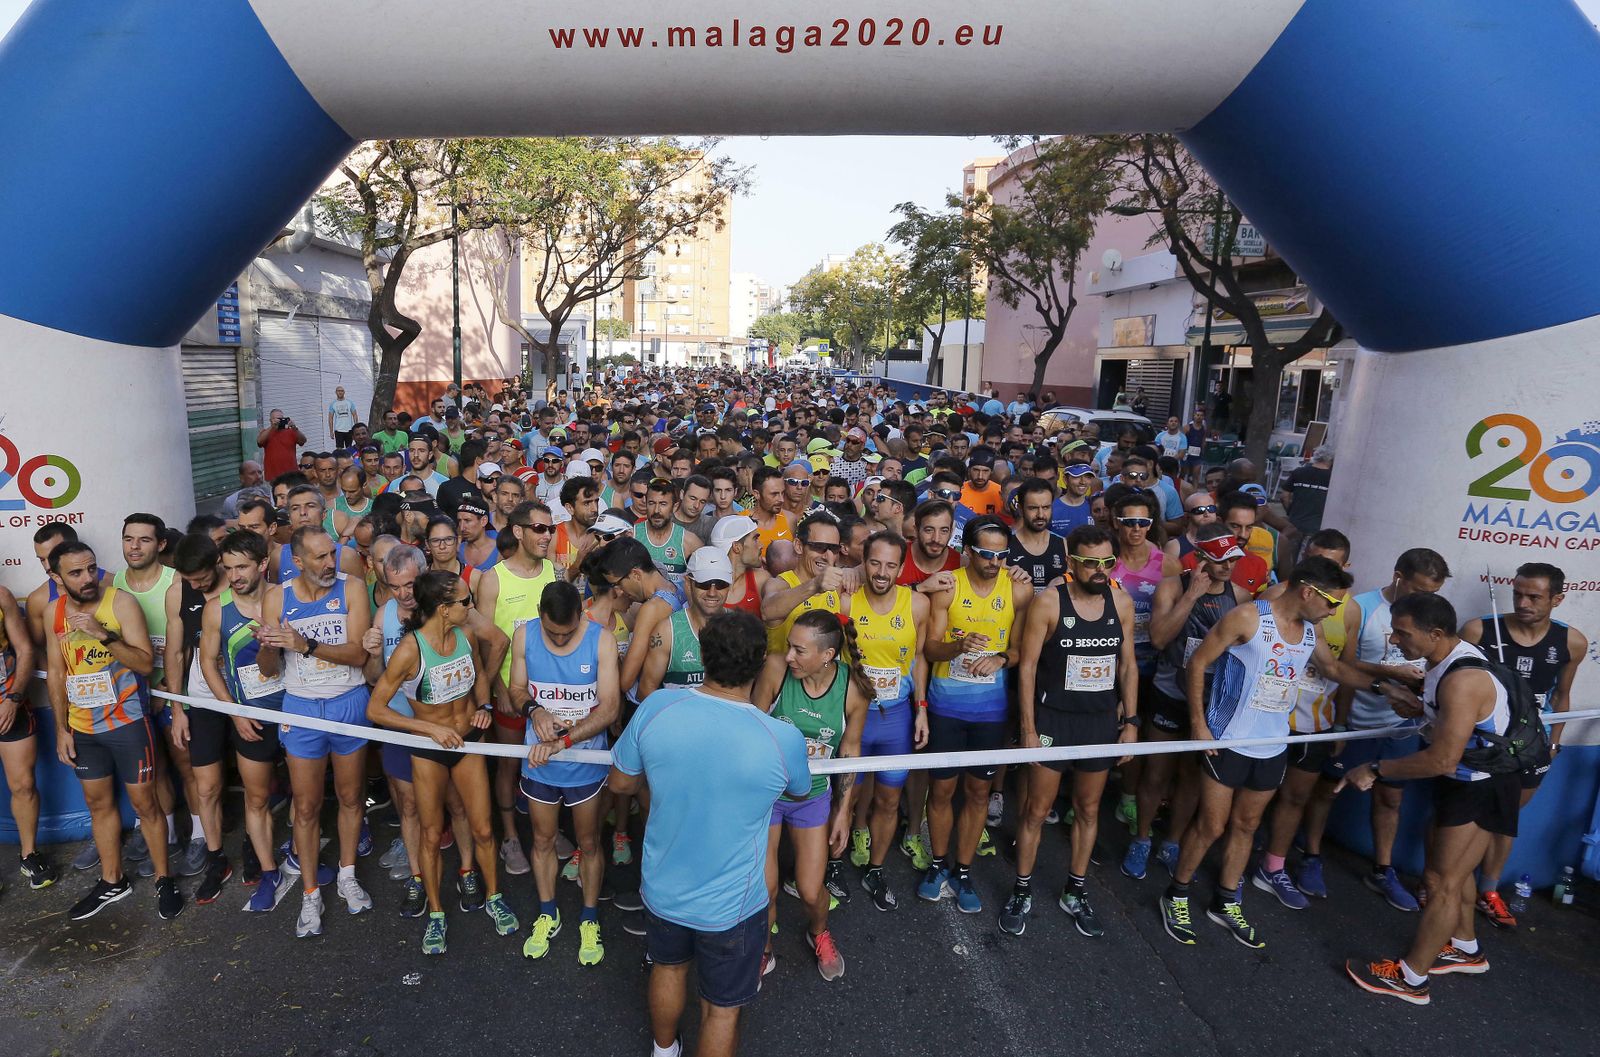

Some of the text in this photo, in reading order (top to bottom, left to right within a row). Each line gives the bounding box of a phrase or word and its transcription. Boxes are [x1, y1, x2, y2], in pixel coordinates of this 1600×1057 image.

[548, 17, 1004, 54] www.malaga2020.eu
[9, 516, 31, 528] OF
[37, 512, 85, 527] SPORT
[1462, 502, 1600, 533] MÁLAGA
[1458, 527, 1559, 549] EUROPEAN
[1060, 638, 1073, 648] CD
[442, 665, 472, 687] 713
[1080, 666, 1110, 679] 531
[77, 680, 109, 697] 275
